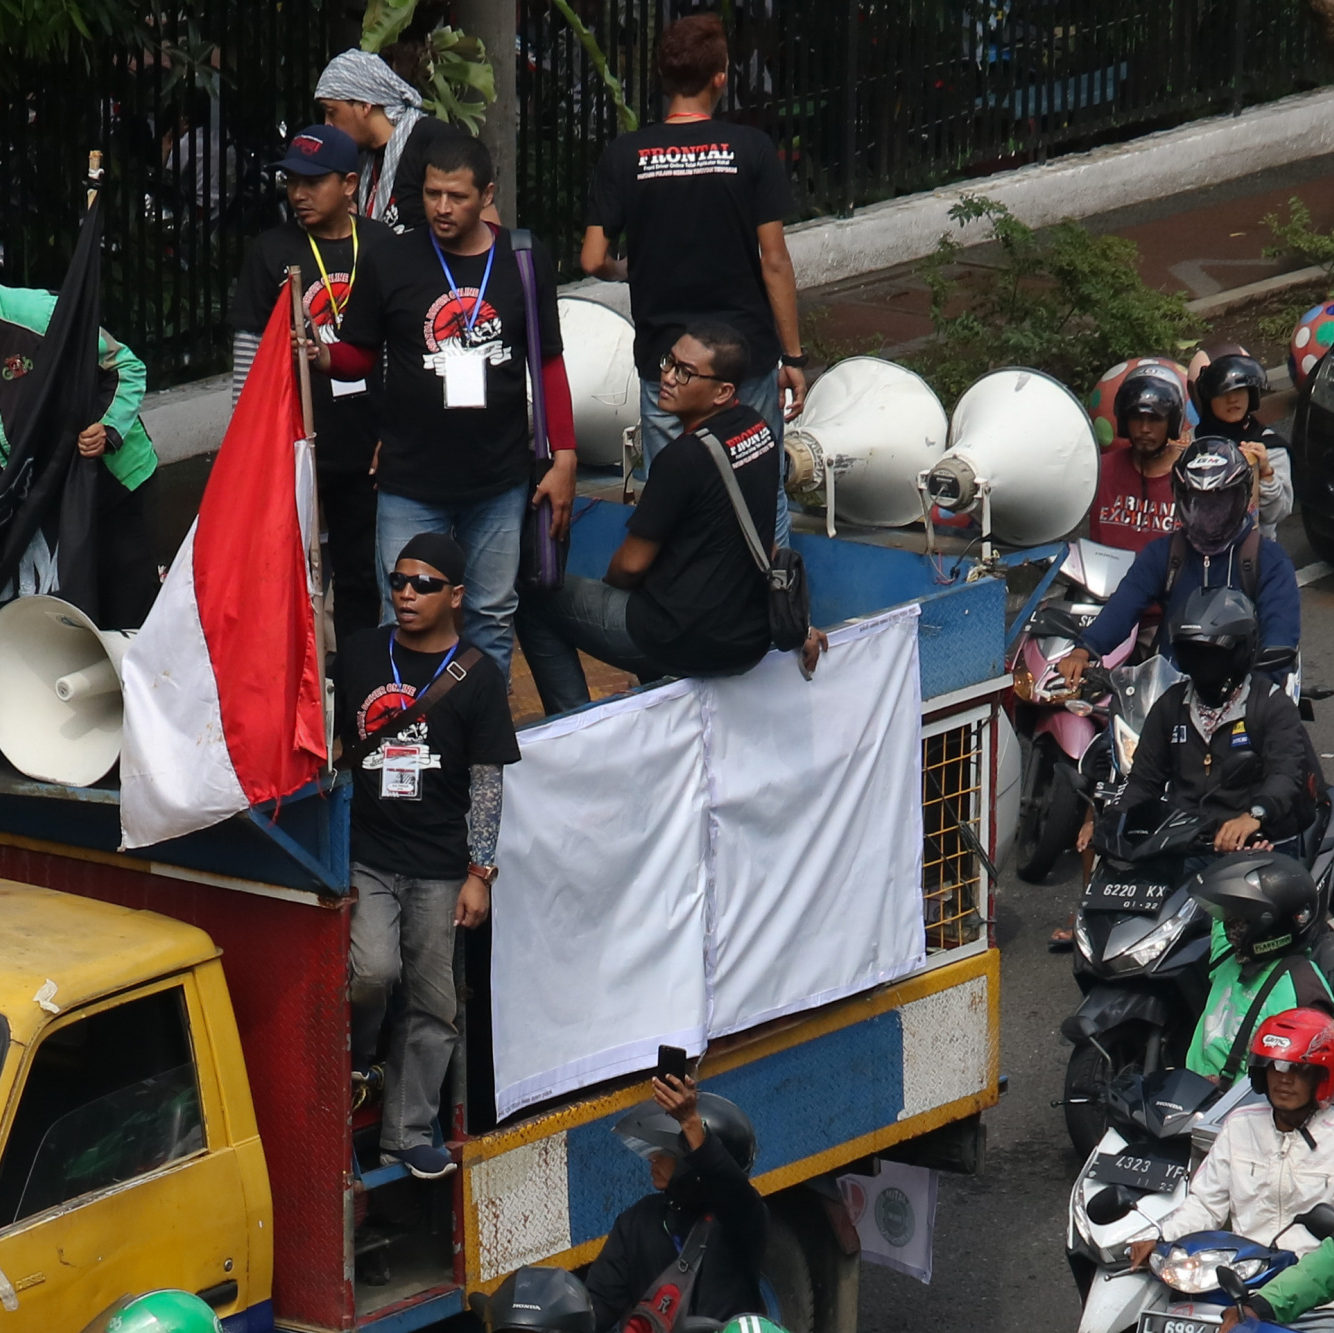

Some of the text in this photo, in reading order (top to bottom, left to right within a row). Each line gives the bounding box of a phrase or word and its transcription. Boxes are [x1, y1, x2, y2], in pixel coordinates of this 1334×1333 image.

[637, 143, 735, 166] FRONTAL
[1113, 495, 1176, 518] ARMANI
[1085, 883, 1165, 898] L 6220 KX
[1155, 1100, 1184, 1111] HONDA
[1115, 1156, 1185, 1179] 4323 YF
[512, 1303, 542, 1311] HONDA
